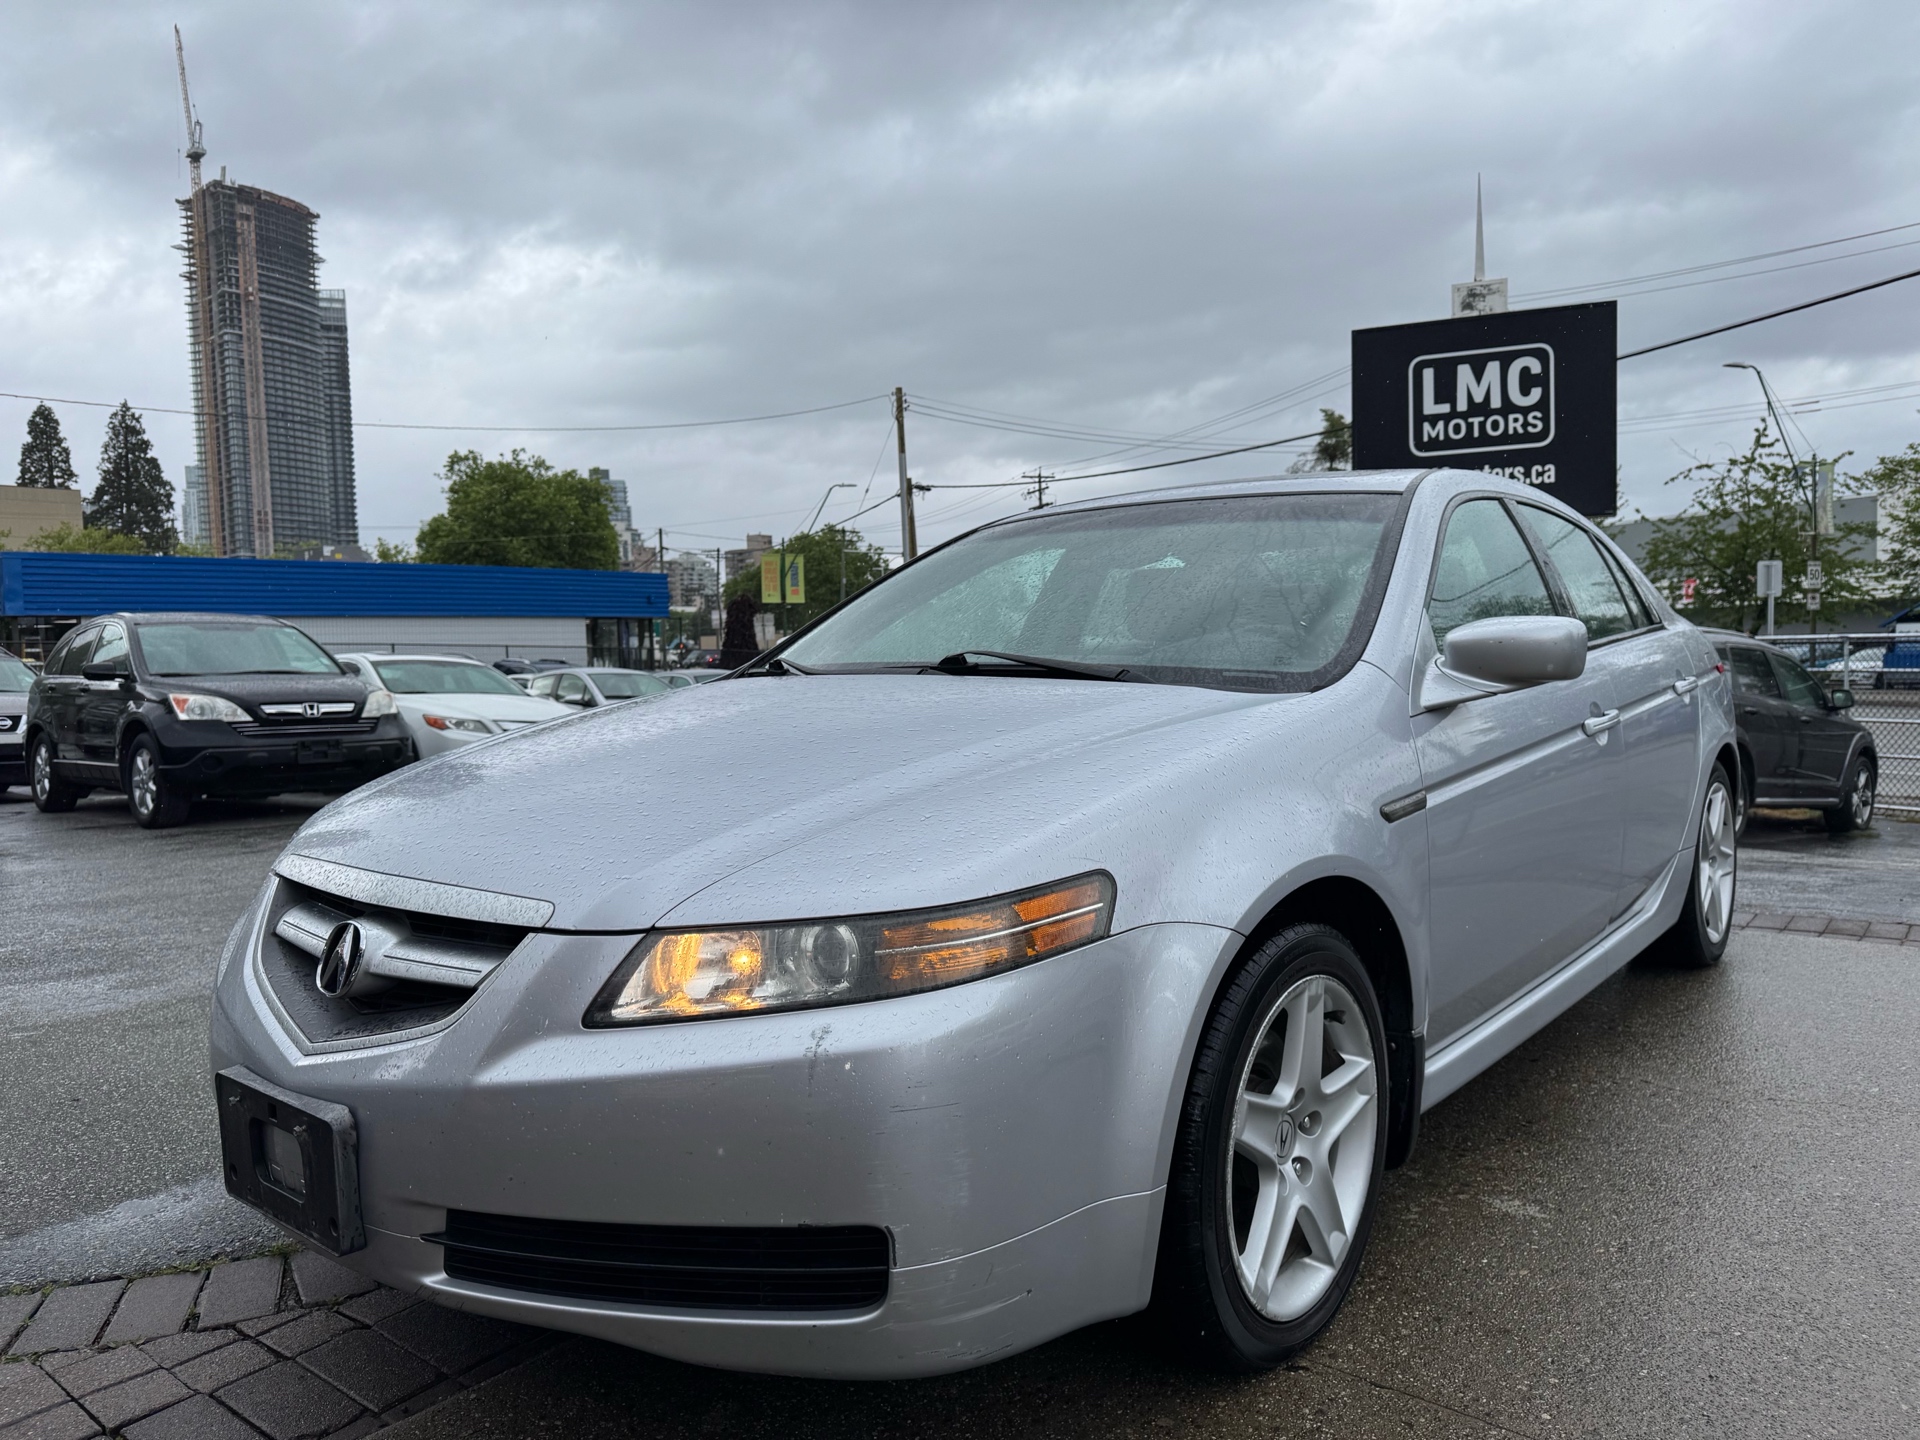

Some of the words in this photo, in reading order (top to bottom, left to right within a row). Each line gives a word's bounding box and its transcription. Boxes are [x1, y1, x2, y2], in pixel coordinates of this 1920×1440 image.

[1422, 356, 1543, 416] LMC
[1423, 411, 1543, 442] MOTORS
[1810, 568, 1820, 581] 50
